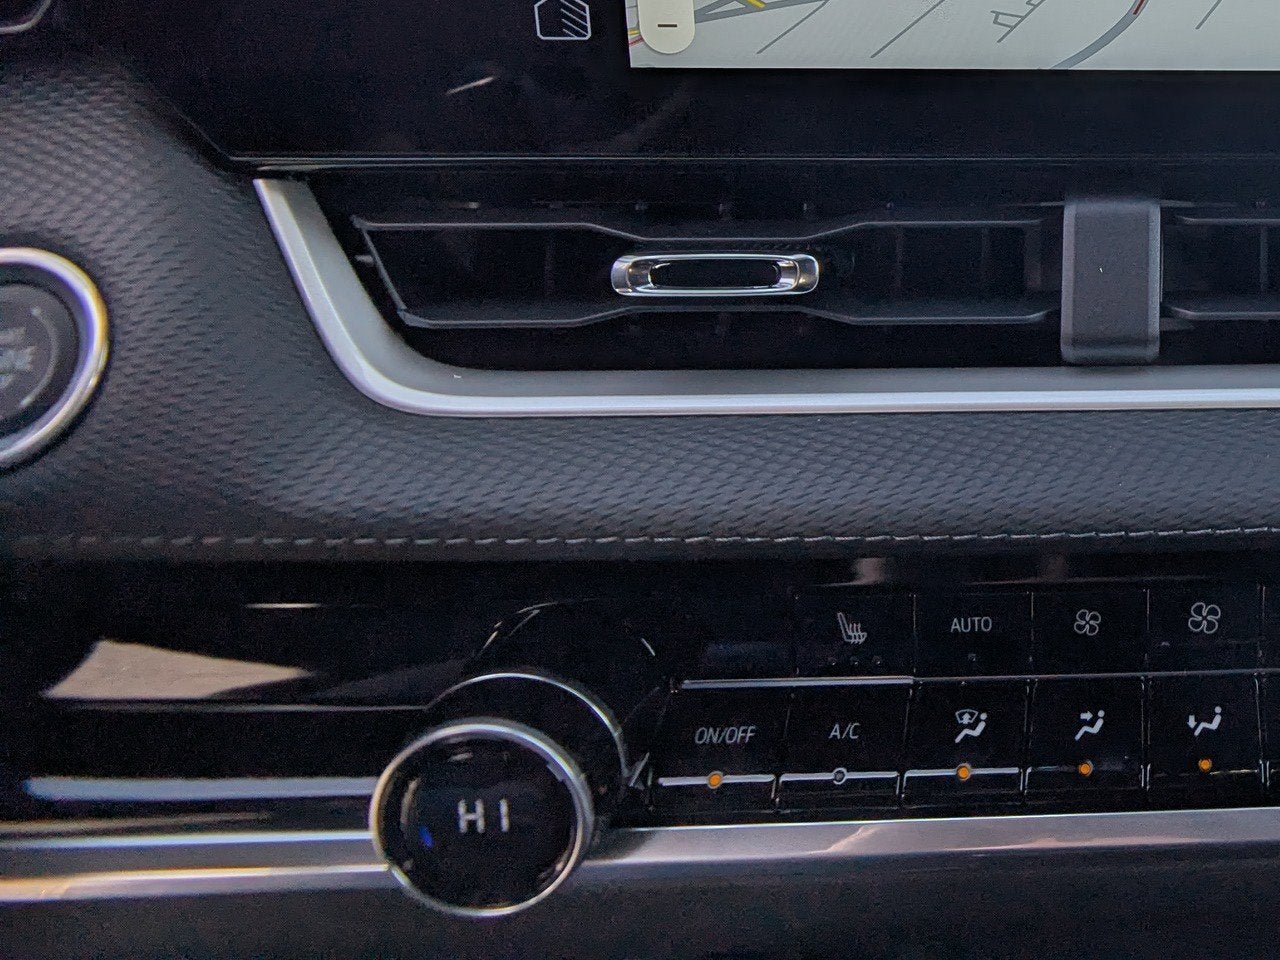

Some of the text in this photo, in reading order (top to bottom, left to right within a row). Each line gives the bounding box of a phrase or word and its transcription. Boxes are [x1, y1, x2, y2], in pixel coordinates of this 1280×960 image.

[951, 616, 993, 633] AUTO
[694, 726, 756, 744] ON/OFF
[828, 722, 860, 739] A/C
